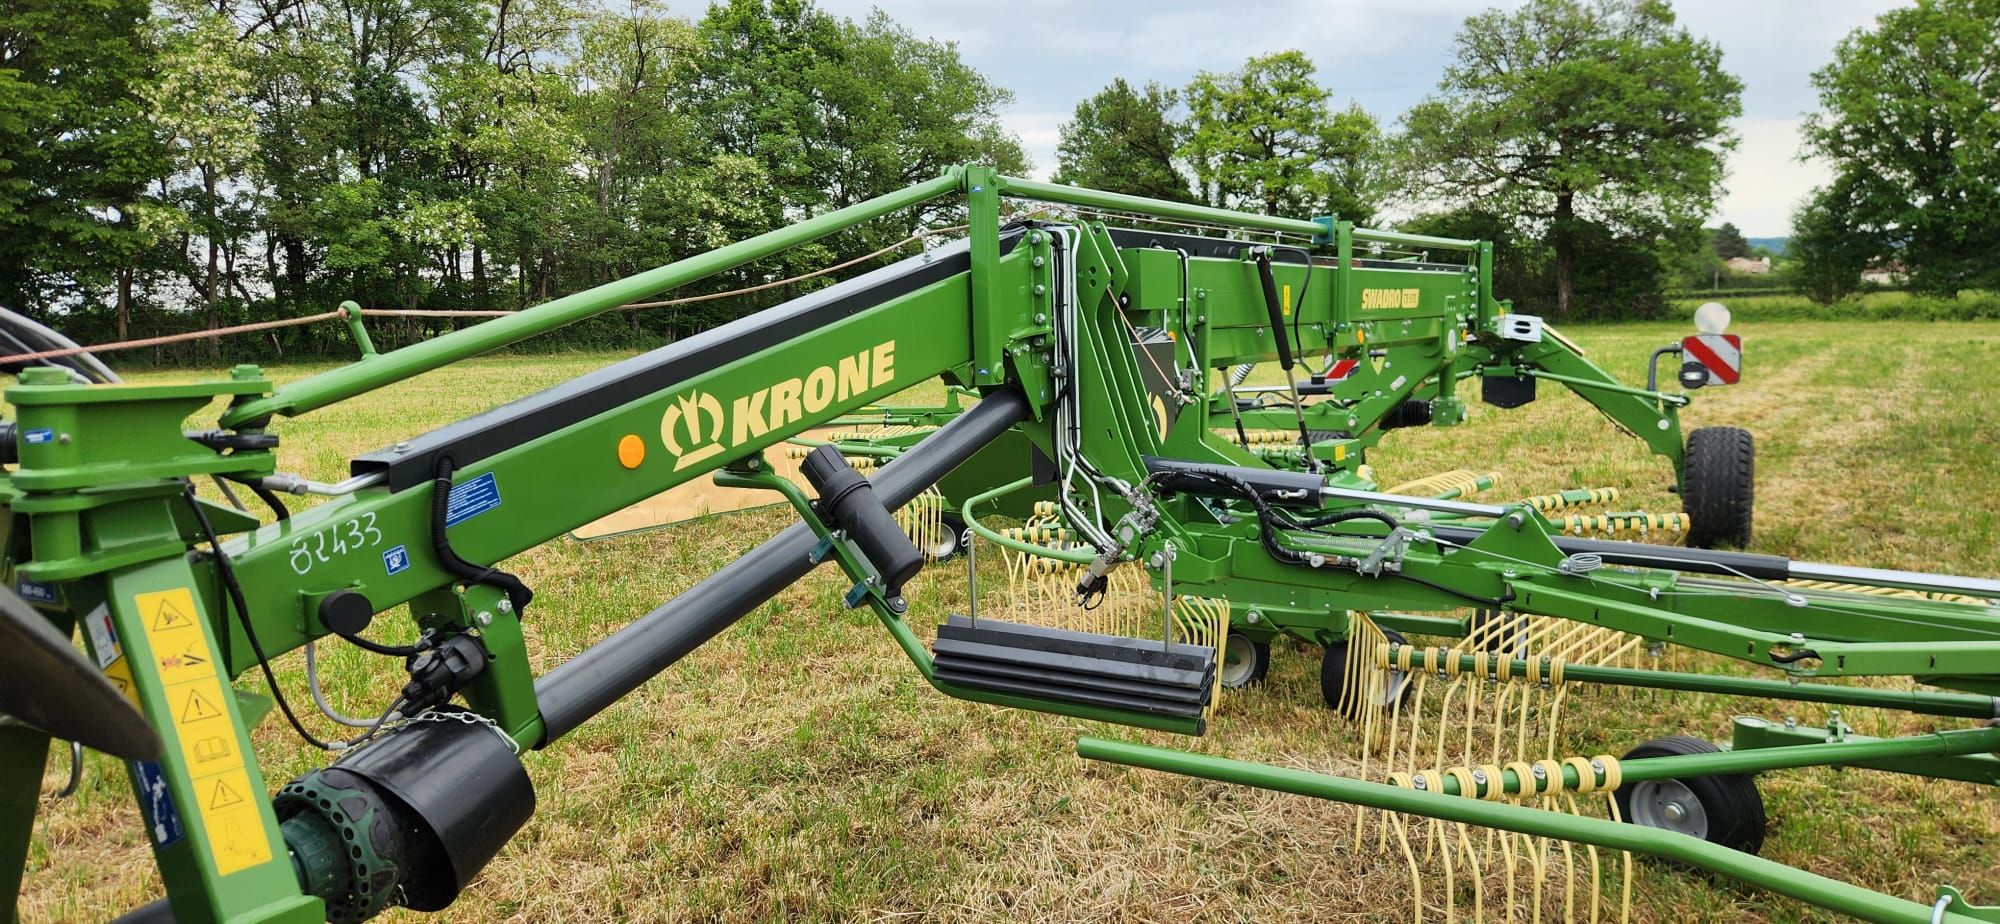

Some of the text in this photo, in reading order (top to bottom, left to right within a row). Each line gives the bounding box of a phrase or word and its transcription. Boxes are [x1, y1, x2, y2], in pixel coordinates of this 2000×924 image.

[1361, 288, 1402, 309] SWADRO
[732, 340, 895, 447] KRONE
[289, 511, 382, 575] 82433
